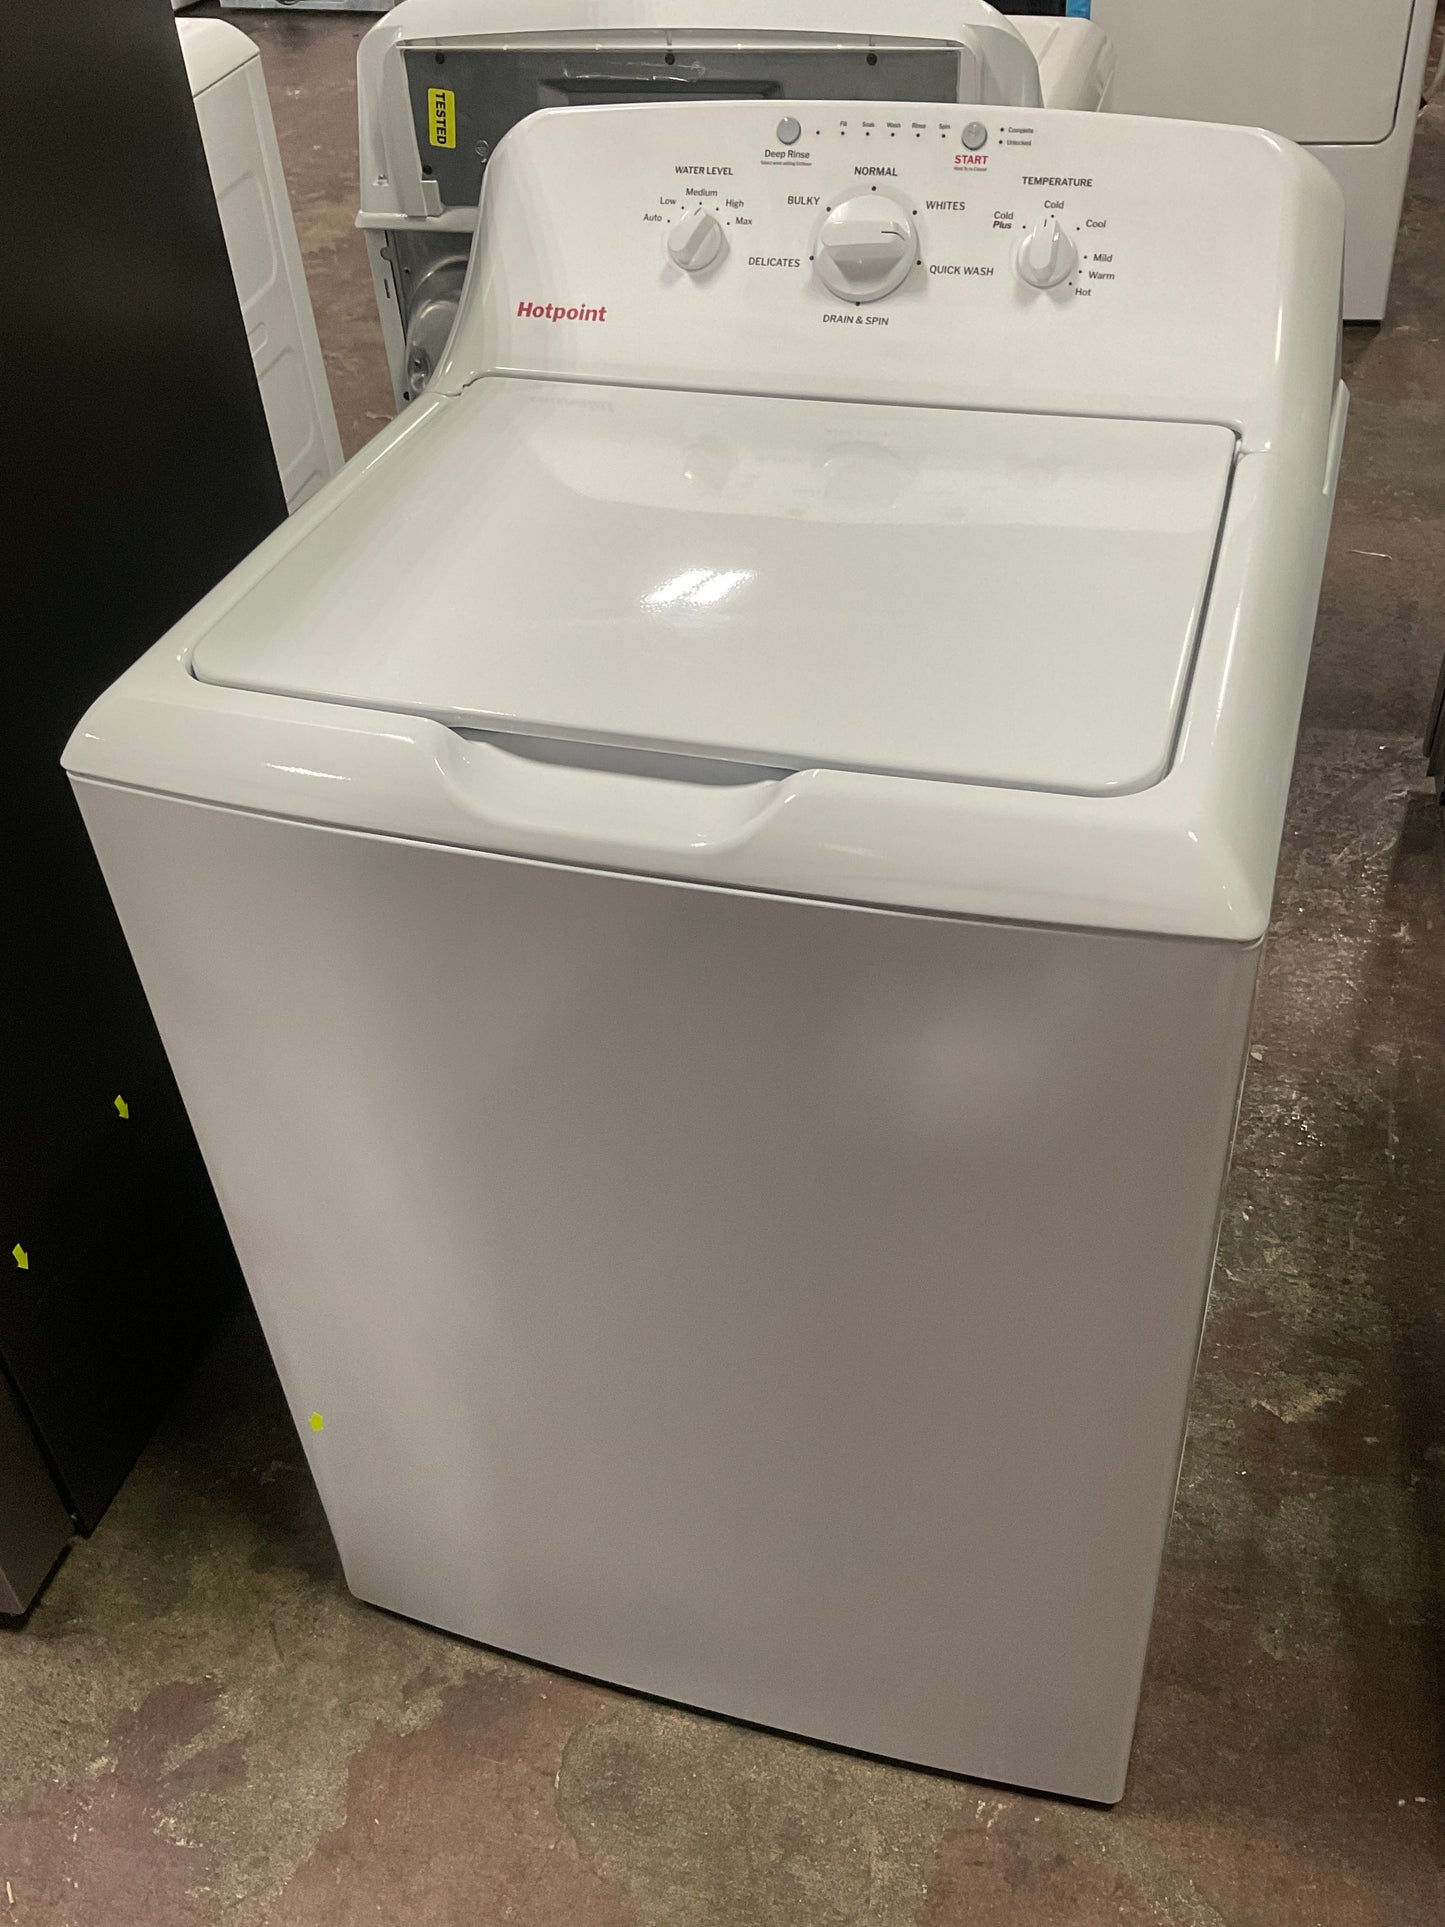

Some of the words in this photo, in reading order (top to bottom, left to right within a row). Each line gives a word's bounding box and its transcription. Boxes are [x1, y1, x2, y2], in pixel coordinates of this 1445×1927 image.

[435, 92, 447, 145] TESTED
[764, 149, 786, 159] Deep
[787, 149, 810, 159] Rinse
[954, 154, 989, 165] START
[675, 166, 705, 175] WATER
[706, 167, 734, 176] LEVEL
[854, 166, 898, 177] NORMAL
[1022, 176, 1093, 187] TEMPERATURE
[686, 187, 718, 197] Medium
[660, 196, 677, 205] Low
[725, 199, 745, 209] High
[787, 195, 821, 206] BULKY
[926, 200, 966, 211] WHITES
[1043, 200, 1064, 209] Cold
[643, 213, 663, 222] Auto
[993, 211, 1014, 220] Cold
[735, 217, 753, 226] Max
[992, 220, 1013, 229] Plus
[1085, 219, 1107, 228] Cool
[748, 257, 801, 268] DELICATES
[1093, 253, 1113, 262] Mild
[929, 264, 961, 275] QUICK
[963, 265, 994, 276] WASH
[1088, 271, 1115, 280] Warm
[1075, 288, 1092, 297] Hot
[517, 302, 608, 322] Hotpoint
[822, 314, 855, 324] DRAIN
[855, 315, 864, 325] &
[865, 316, 890, 326] SPIN
